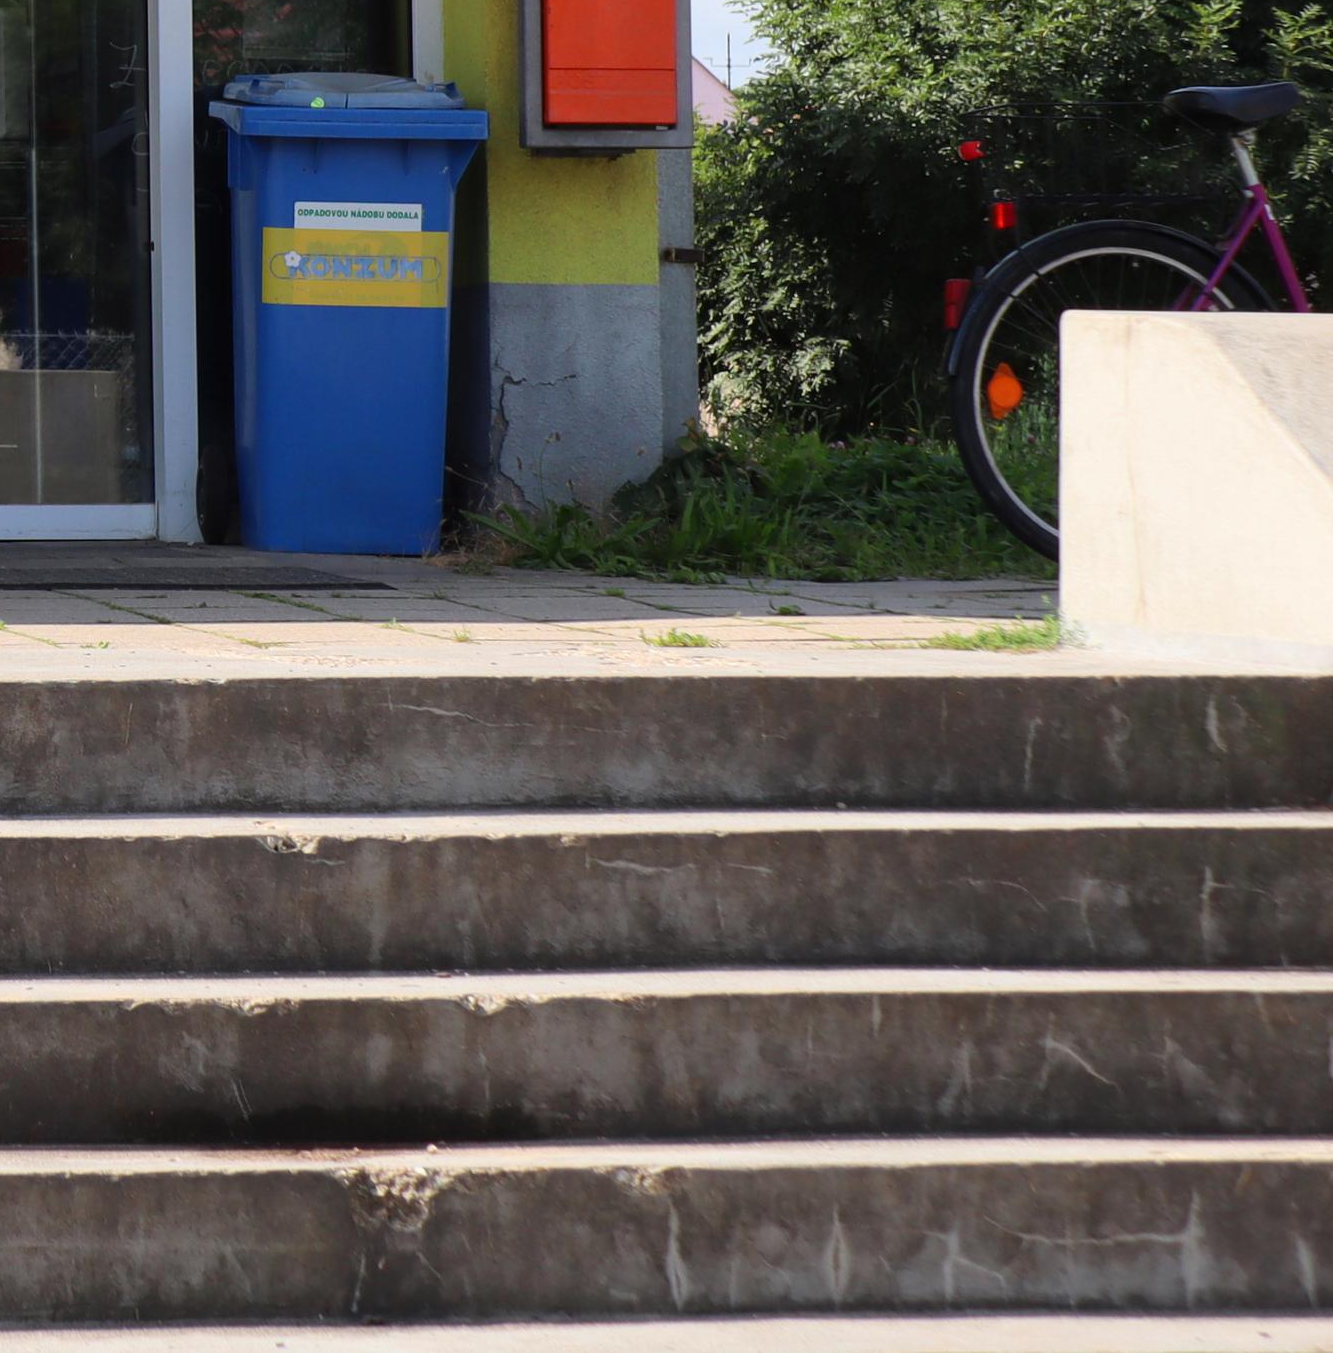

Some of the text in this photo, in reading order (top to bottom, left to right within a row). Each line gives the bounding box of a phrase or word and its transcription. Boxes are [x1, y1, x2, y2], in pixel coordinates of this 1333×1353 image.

[297, 208, 348, 218] ODPADOVOU
[387, 210, 419, 220] DODALA
[288, 255, 423, 279] KONZUM
